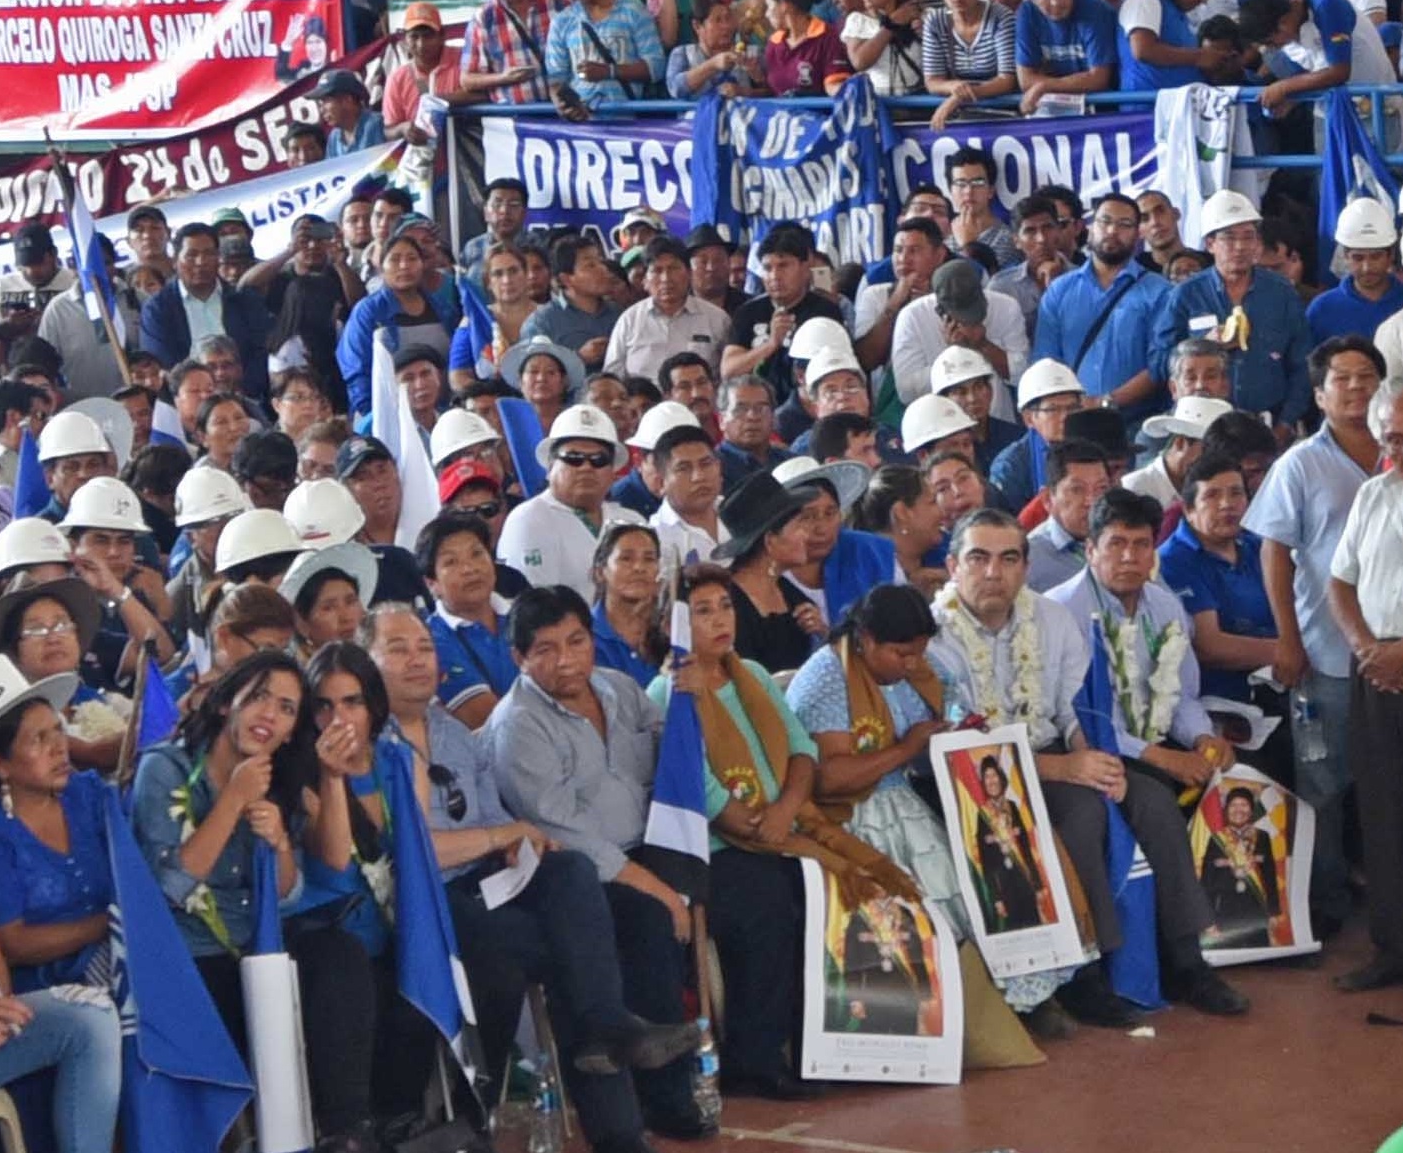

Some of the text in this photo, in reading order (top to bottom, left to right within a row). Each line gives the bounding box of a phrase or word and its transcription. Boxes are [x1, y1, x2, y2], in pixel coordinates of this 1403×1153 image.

[58, 13, 151, 65] QUIROGA
[218, 8, 278, 60] CRUZ
[120, 147, 179, 204] 24
[182, 136, 231, 192] de
[522, 136, 694, 213] DIRECC
